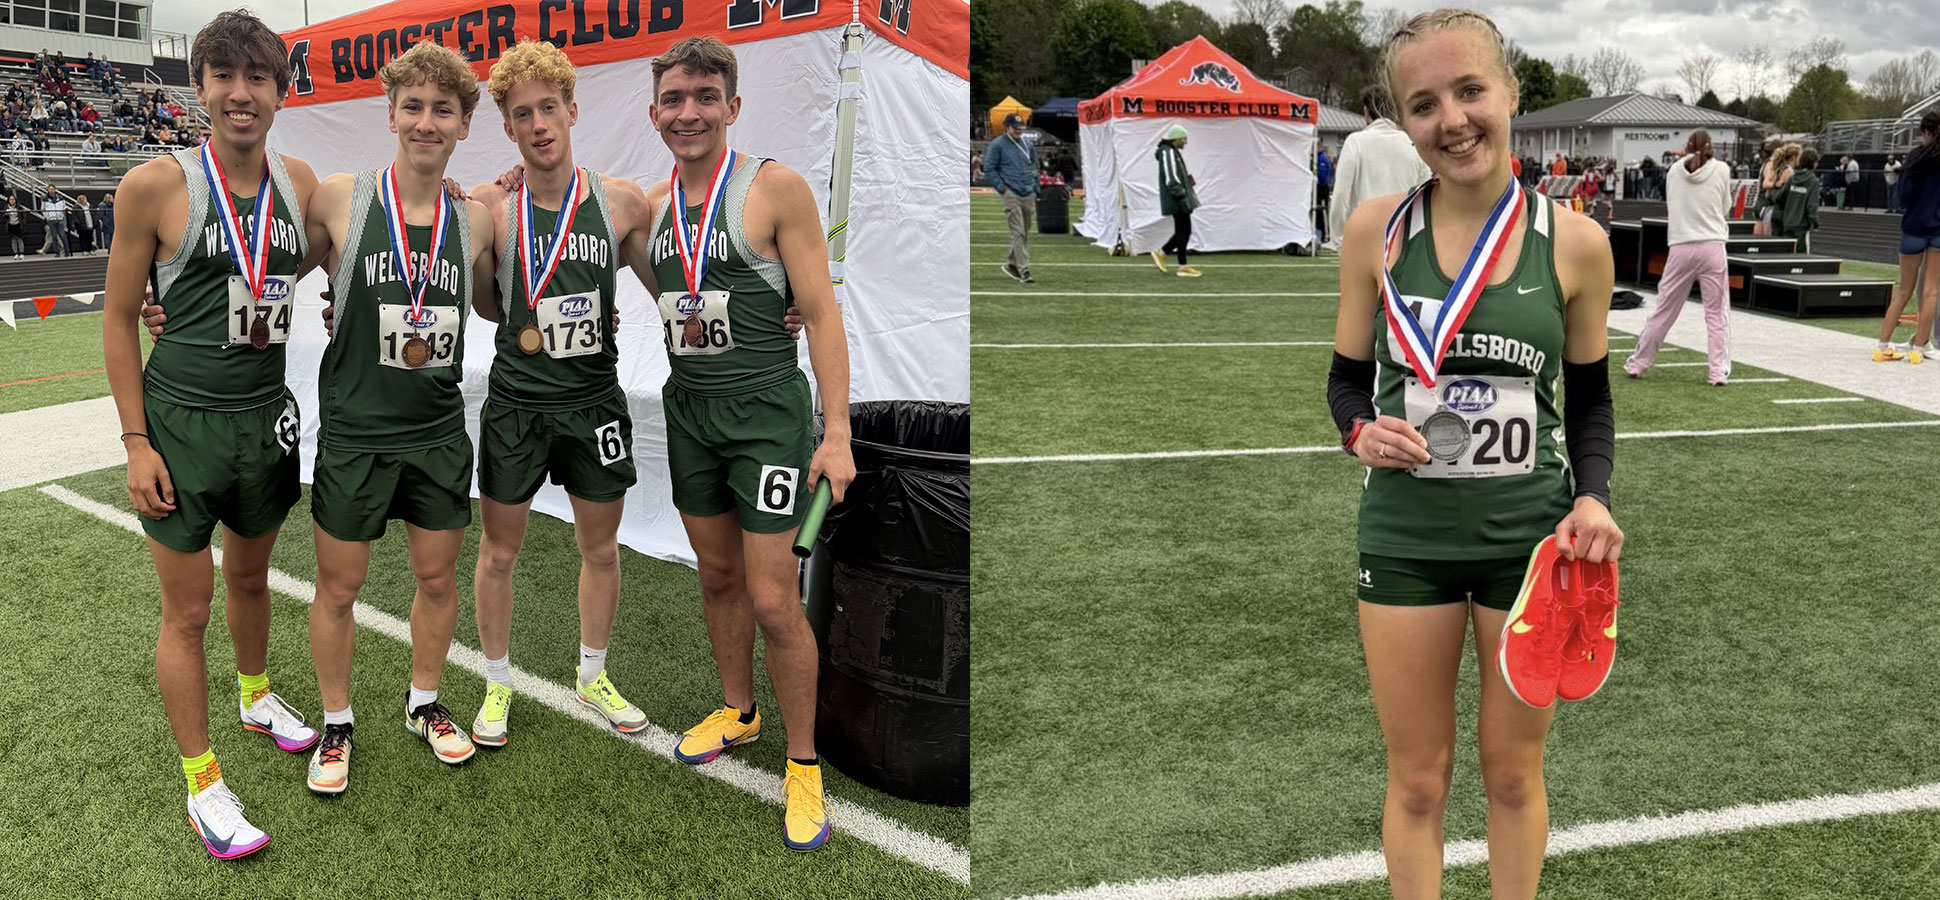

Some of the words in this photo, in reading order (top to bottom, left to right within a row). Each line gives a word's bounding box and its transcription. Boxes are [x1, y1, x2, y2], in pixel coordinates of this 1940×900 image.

[331, 4, 516, 84] BOOSTER
[539, 0, 684, 49] CLUB
[1122, 97, 1145, 115] M
[1155, 99, 1232, 116] BOOSTER
[1237, 103, 1280, 117] CLUB
[1290, 103, 1310, 119] M
[1624, 132, 1670, 141] RESTROOMS
[205, 214, 297, 258] WESORO
[655, 224, 728, 266] WELBRO
[262, 283, 288, 295] IAA
[365, 251, 459, 296] WELSBORO
[405, 311, 436, 323] PAA
[561, 299, 591, 313] PIAA
[1444, 333, 1546, 374] LSBORO
[1445, 386, 1495, 404] PIAA
[279, 415, 298, 448] 6
[601, 425, 621, 460] 6
[763, 469, 792, 510] 6
